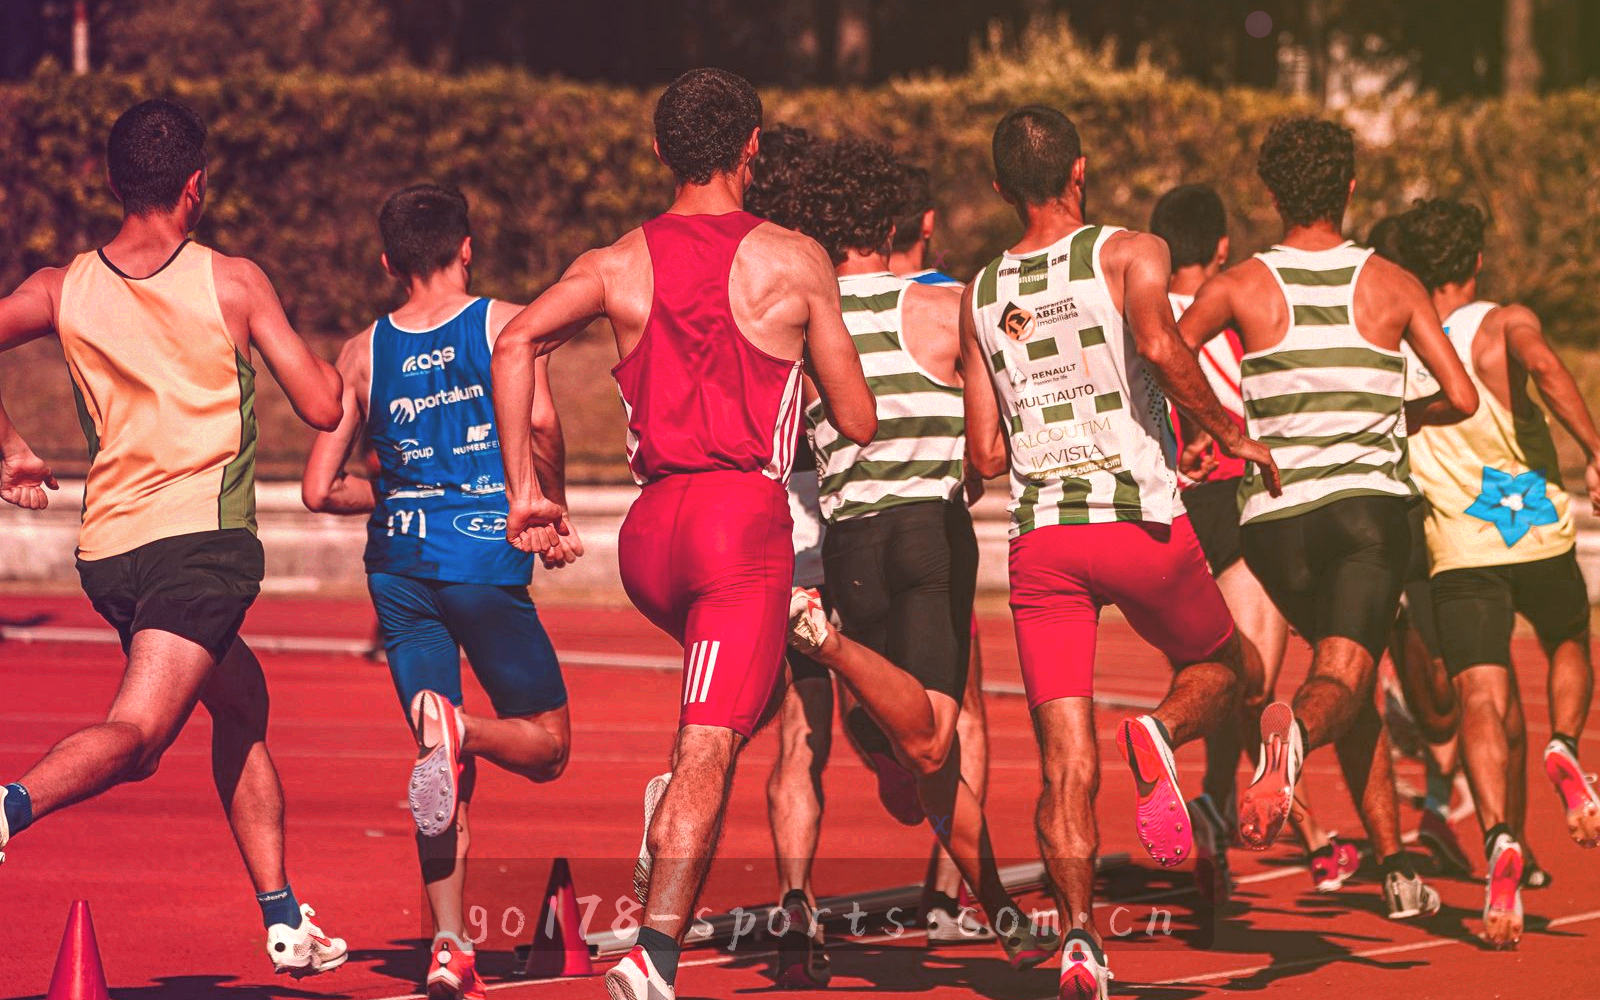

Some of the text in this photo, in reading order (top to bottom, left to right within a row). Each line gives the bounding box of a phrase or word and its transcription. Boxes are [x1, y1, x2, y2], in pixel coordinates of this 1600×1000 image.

[1036, 302, 1076, 319] ABERTA
[1031, 363, 1076, 380] RENAULT
[415, 384, 484, 414] portalum
[1014, 383, 1095, 412] MULTIAUTO
[466, 423, 492, 442] NF
[1016, 417, 1112, 452] ALCOUTIM
[402, 446, 434, 465] group
